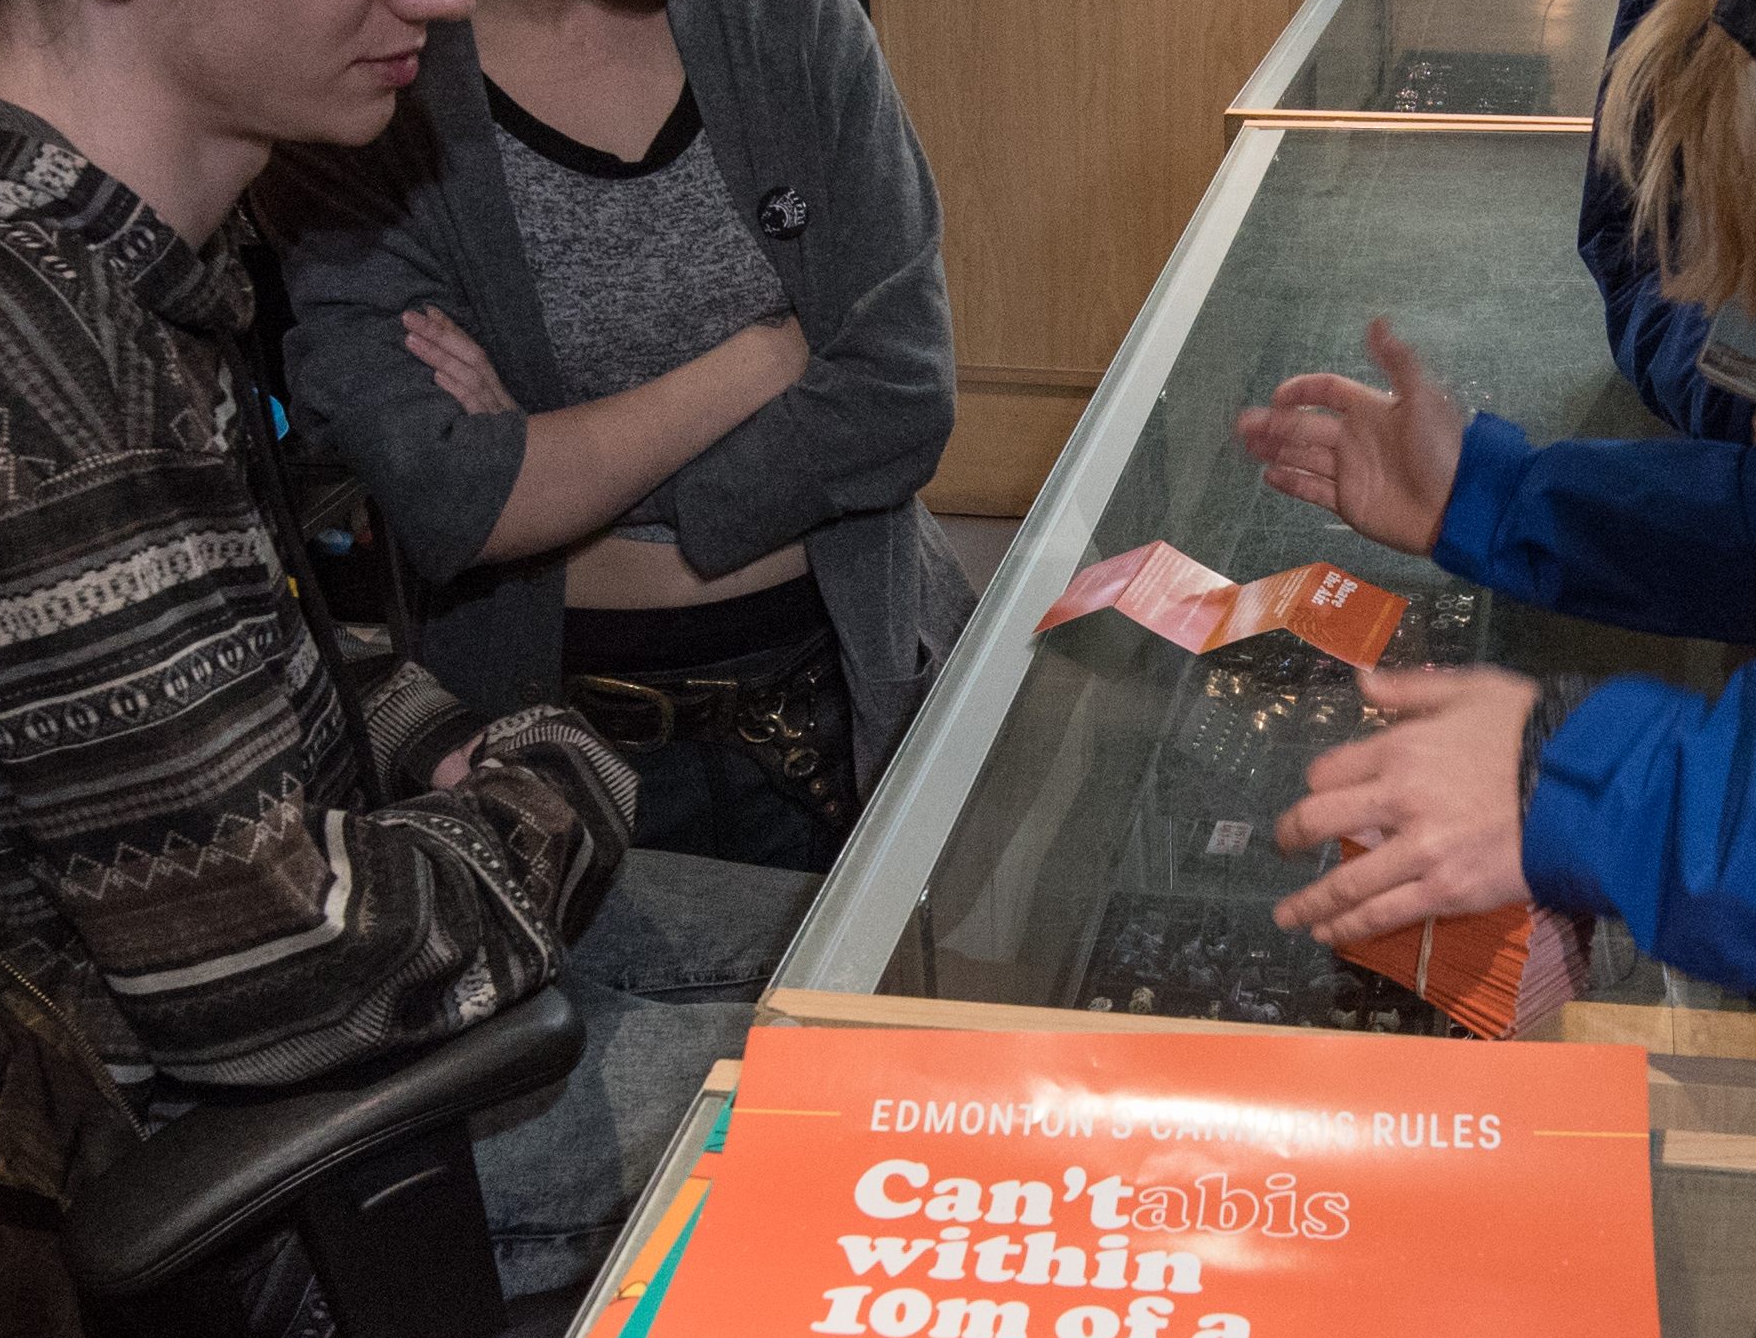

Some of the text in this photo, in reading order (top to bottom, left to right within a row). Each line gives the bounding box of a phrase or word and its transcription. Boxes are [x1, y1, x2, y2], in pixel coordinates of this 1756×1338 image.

[1330, 577, 1359, 608] Share
[870, 1098, 1131, 1142] EDMONTONS
[1372, 1112, 1502, 1151] RULES
[838, 1227, 1202, 1293] within
